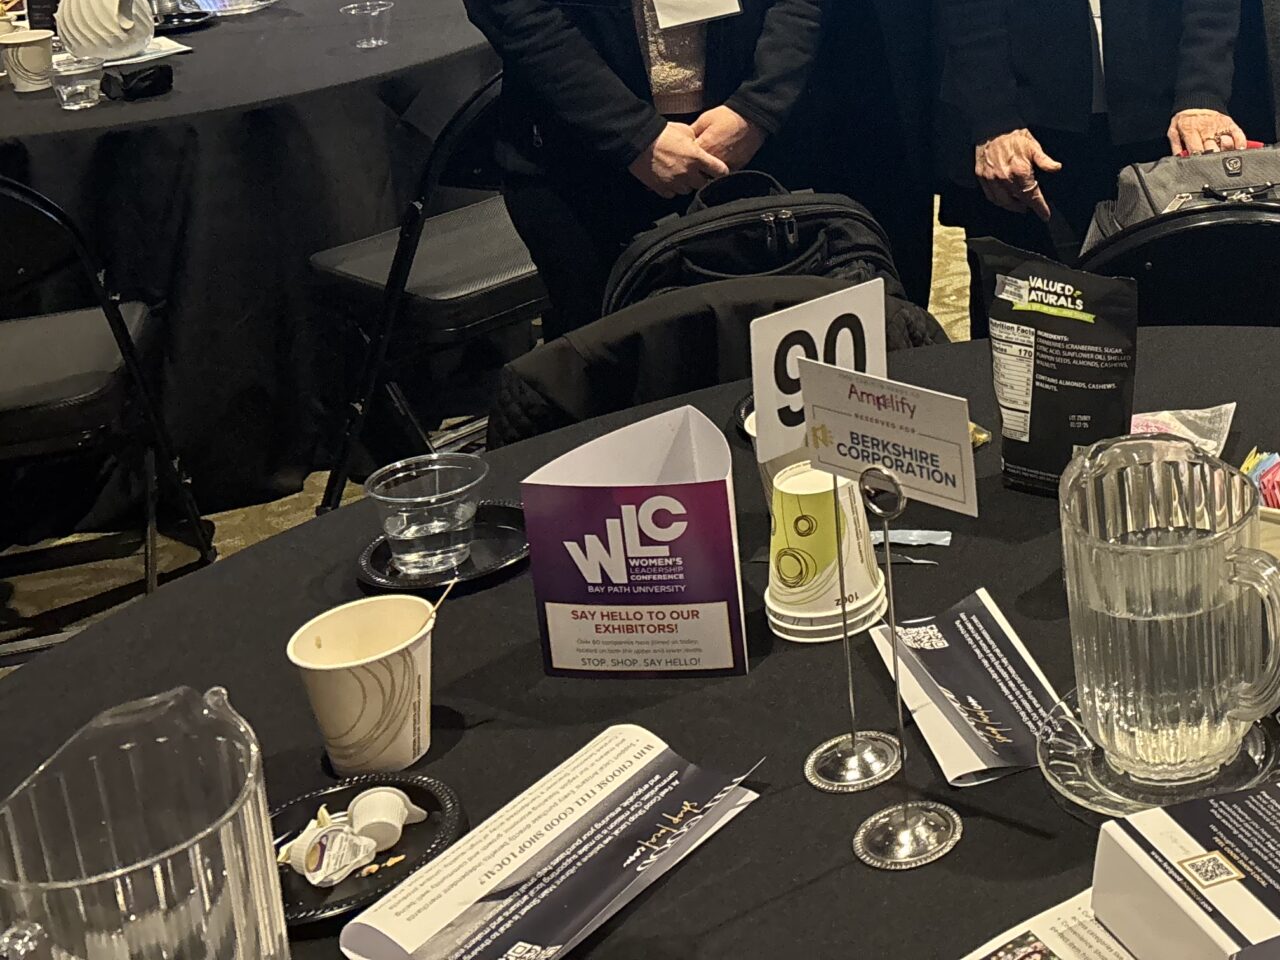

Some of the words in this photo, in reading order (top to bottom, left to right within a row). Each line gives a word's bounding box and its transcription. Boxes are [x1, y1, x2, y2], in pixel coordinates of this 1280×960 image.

[1028, 275, 1074, 296] VALUED
[1029, 290, 1084, 310] ATURALS
[1018, 348, 1033, 358] 170
[848, 383, 917, 419] Amplify
[854, 413, 896, 430] RESERVED
[899, 424, 916, 434] FOR
[849, 431, 939, 468] BERKSHIRE
[837, 443, 956, 488] CORPORATION
[563, 495, 688, 584] WLC
[629, 557, 683, 567] WOMEN'S
[630, 566, 684, 574] LEADERSHIP
[630, 573, 684, 581] CONFERENCE
[588, 585, 606, 593] BAY
[607, 585, 631, 593] PATH
[632, 584, 687, 593] UNIVERSITY
[571, 610, 597, 620] SAY
[600, 610, 644, 621] HELLO
[647, 610, 667, 620] TO
[670, 609, 700, 620] OUR
[594, 623, 679, 634] EXHIBITORS!
[581, 657, 607, 666] STOP.
[643, 657, 665, 667] SAY
[667, 657, 701, 667] HELLO!
[658, 785, 672, 797] Feel
[643, 795, 660, 810] Good
[544, 806, 574, 831] GOOD
[628, 809, 645, 822] Shop
[518, 830, 544, 853] SHOP
[602, 835, 612, 844] we
[538, 884, 556, 898] Main
